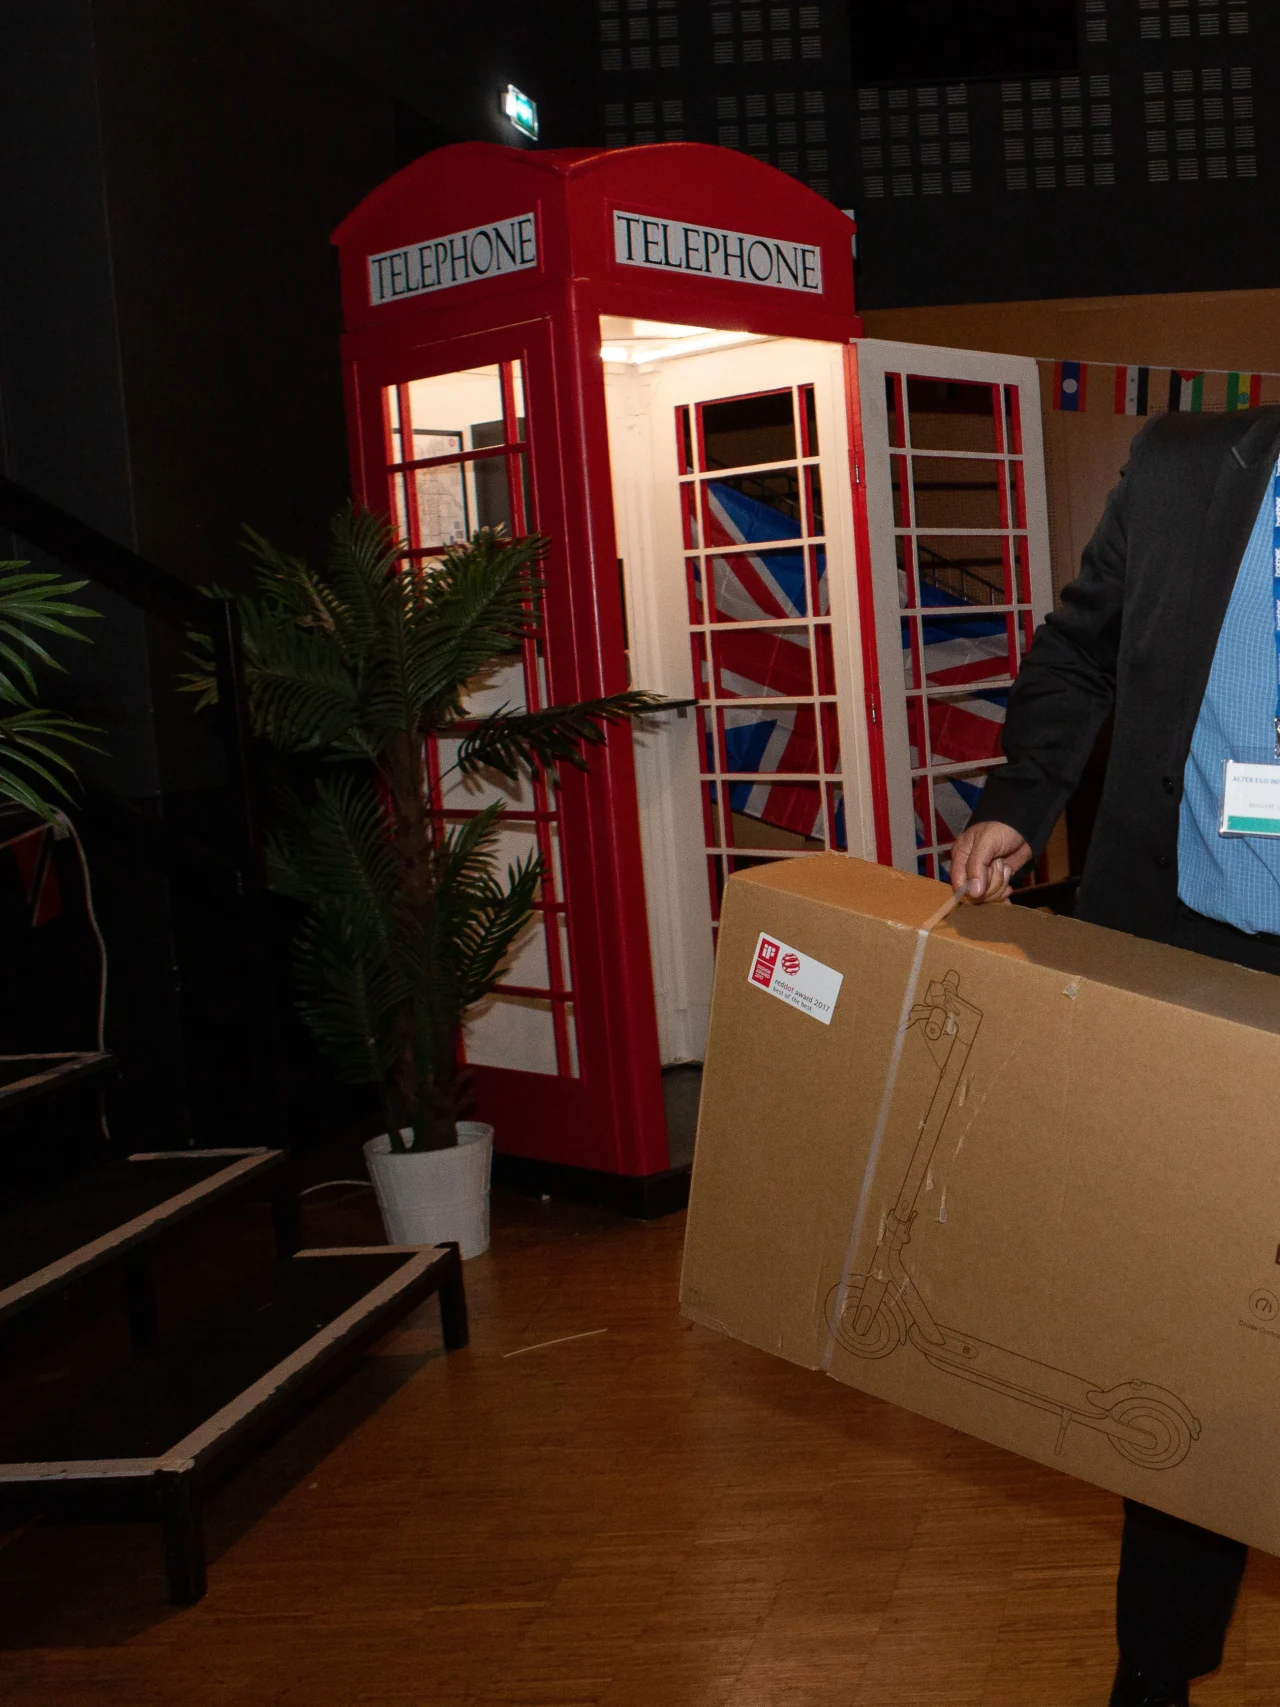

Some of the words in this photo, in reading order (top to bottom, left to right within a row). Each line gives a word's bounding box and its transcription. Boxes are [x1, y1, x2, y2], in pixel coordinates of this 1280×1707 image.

[371, 218, 536, 300] TELEPHONE
[616, 215, 820, 290] TELEPHONE
[772, 986, 784, 997] best
[791, 996, 800, 1005] the
[800, 1001, 813, 1012] best
[794, 990, 814, 1003] award
[813, 999, 831, 1012] 2017
